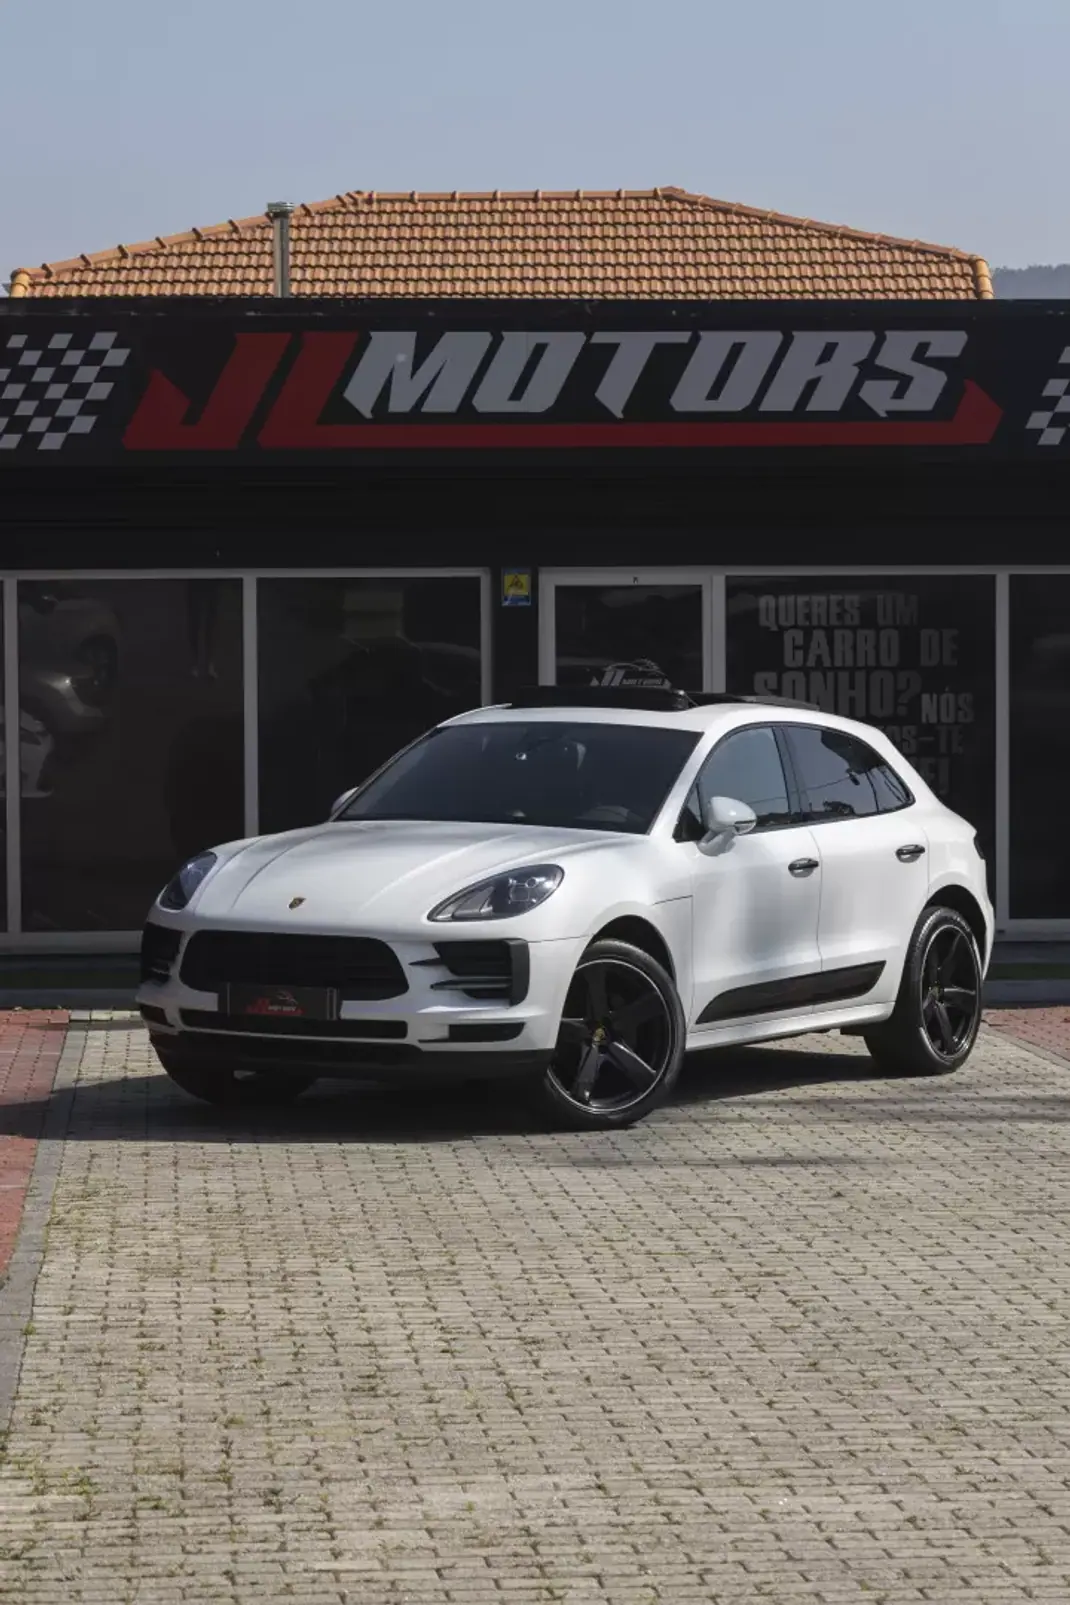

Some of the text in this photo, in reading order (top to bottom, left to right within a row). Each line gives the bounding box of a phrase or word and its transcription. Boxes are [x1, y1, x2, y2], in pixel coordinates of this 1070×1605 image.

[343, 330, 968, 419] MOTORS
[758, 594, 918, 631] QUERES UM
[783, 629, 959, 667] CARRO DE
[921, 686, 974, 723] NÓS
